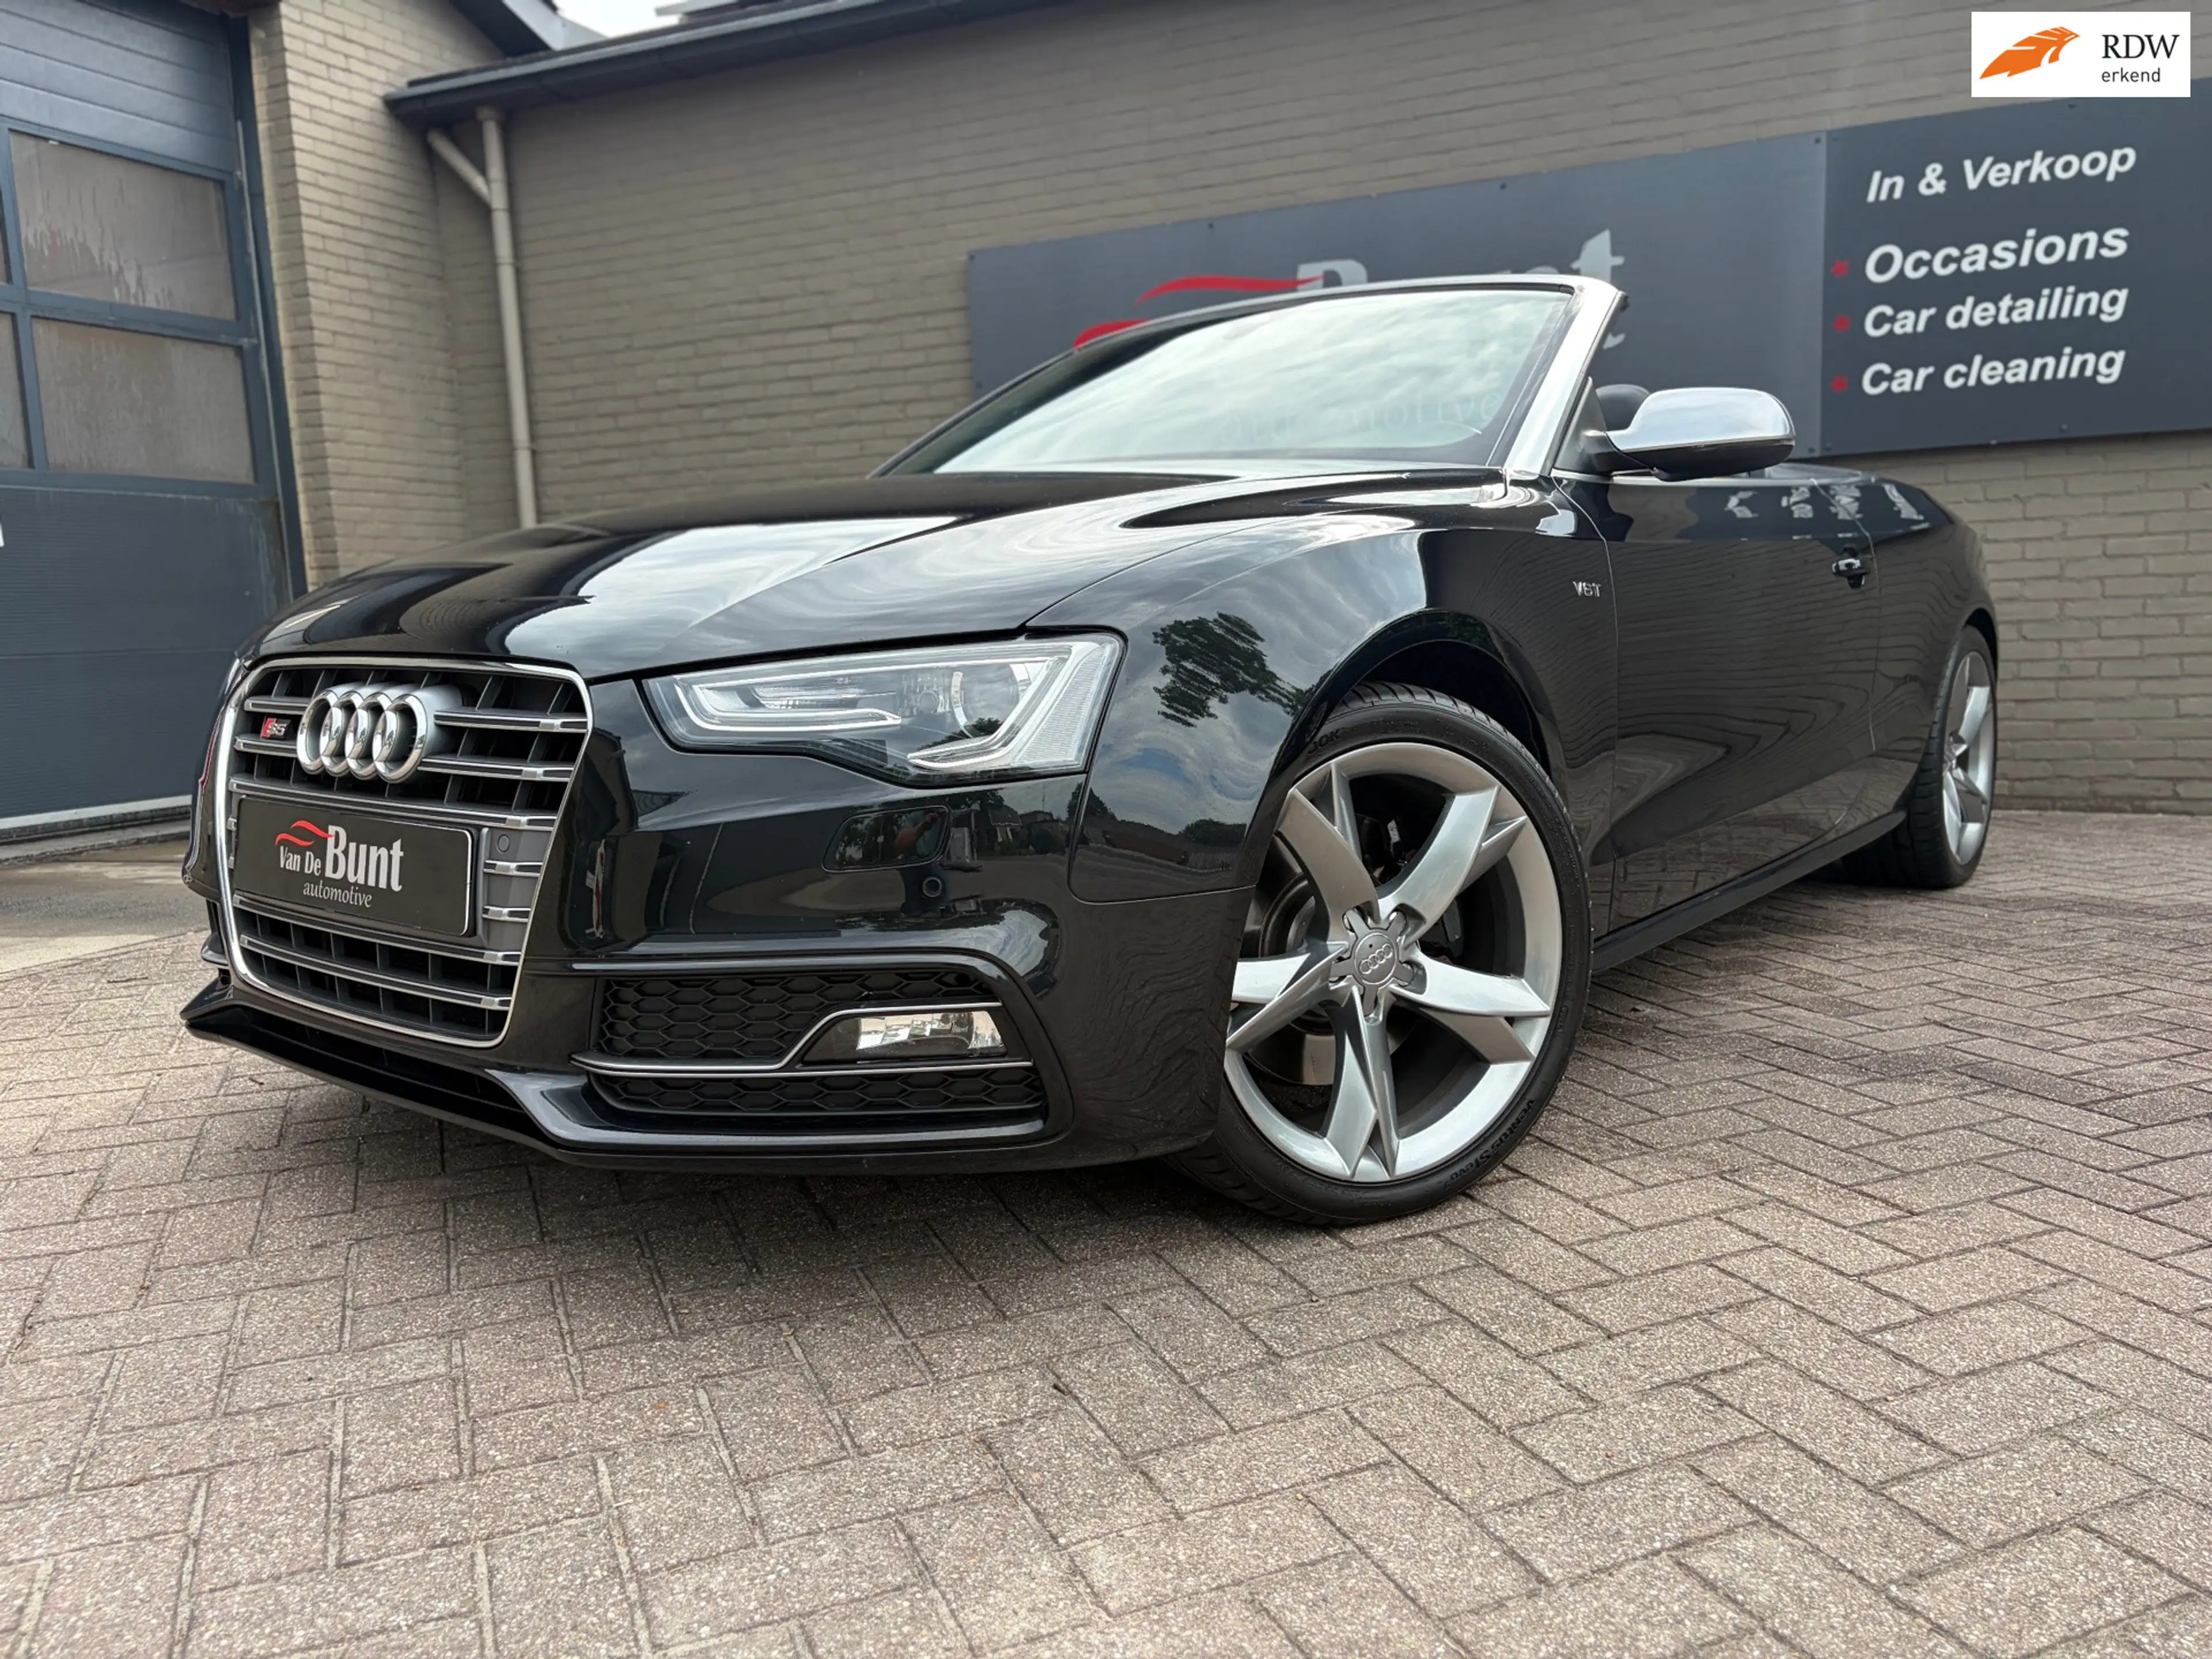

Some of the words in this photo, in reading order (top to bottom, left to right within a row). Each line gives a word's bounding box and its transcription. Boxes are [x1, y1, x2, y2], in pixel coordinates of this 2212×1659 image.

[1866, 171, 1904, 203] In
[1918, 162, 1947, 196] &
[1963, 146, 2137, 191] Verkoop
[1865, 227, 2130, 283] Occasions
[1864, 304, 1937, 338] Car
[1945, 285, 2129, 330] detailing
[1862, 362, 1935, 395] Car
[1944, 346, 2126, 389] cleaning
[279, 845, 301, 872] Van
[304, 851, 322, 877] De
[324, 824, 404, 892] Bunt
[303, 880, 373, 908] automotive
